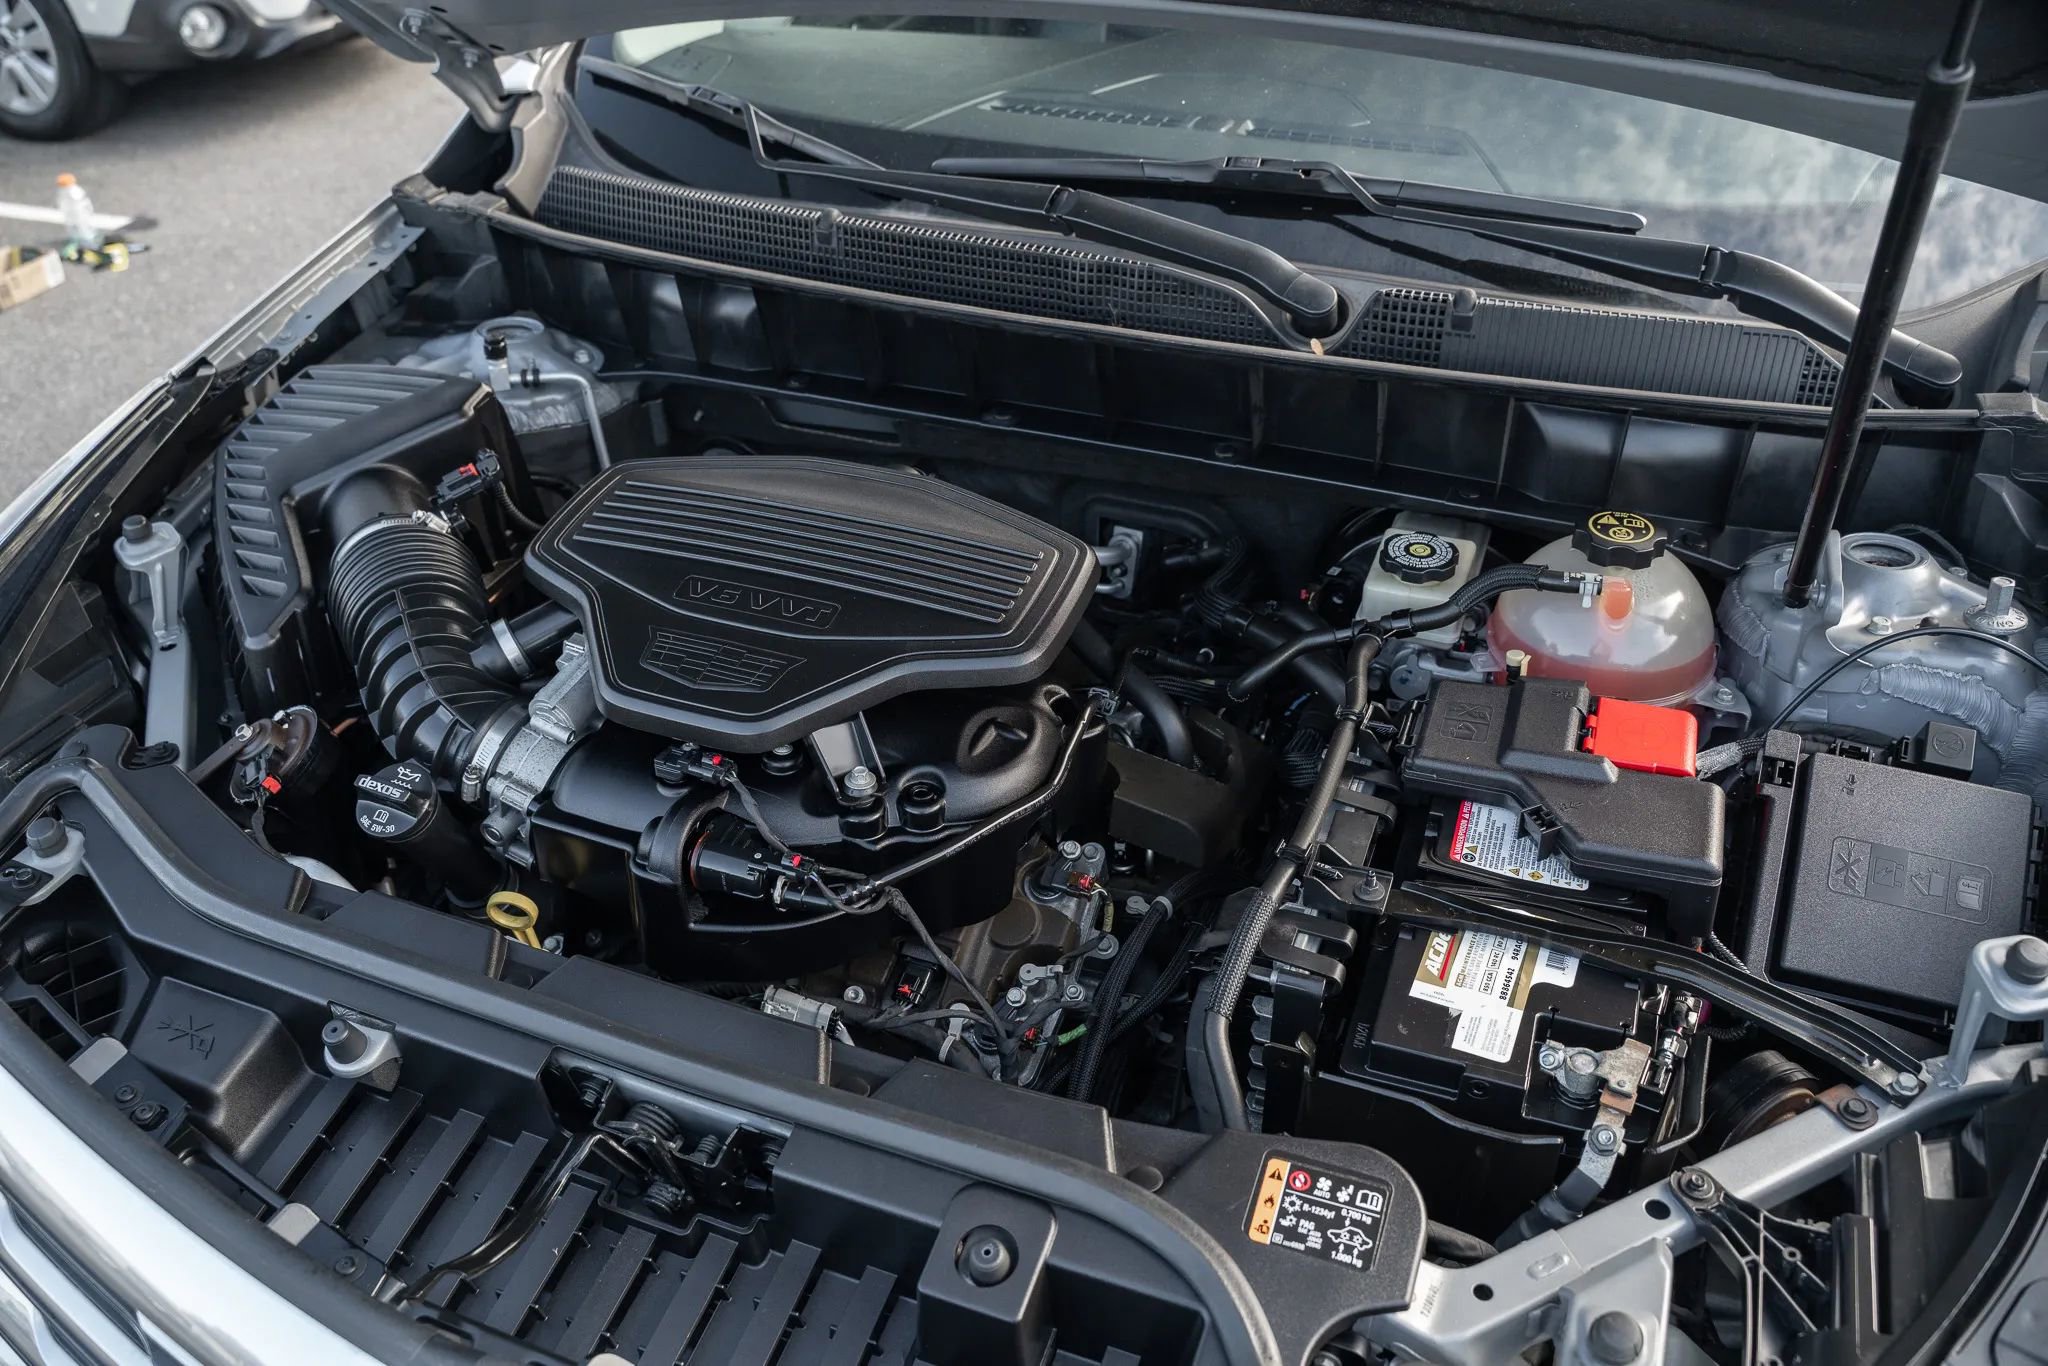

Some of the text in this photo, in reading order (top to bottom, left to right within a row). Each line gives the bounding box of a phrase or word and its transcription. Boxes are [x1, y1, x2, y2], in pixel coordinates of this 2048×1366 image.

[689, 579, 833, 622] V6 VVT
[358, 776, 404, 798] dexos
[360, 815, 395, 833] SAE 5W-30
[1461, 940, 1476, 973] MAINTENANCE
[1499, 968, 1515, 1000] 88864542
[1313, 1190, 1331, 1200] AUTO
[1302, 1202, 1336, 1219] R-1234yf
[1341, 1208, 1372, 1225] 0.700 kg
[1299, 1219, 1315, 1230] PAG
[1331, 1251, 1363, 1268] 1.000 kg
